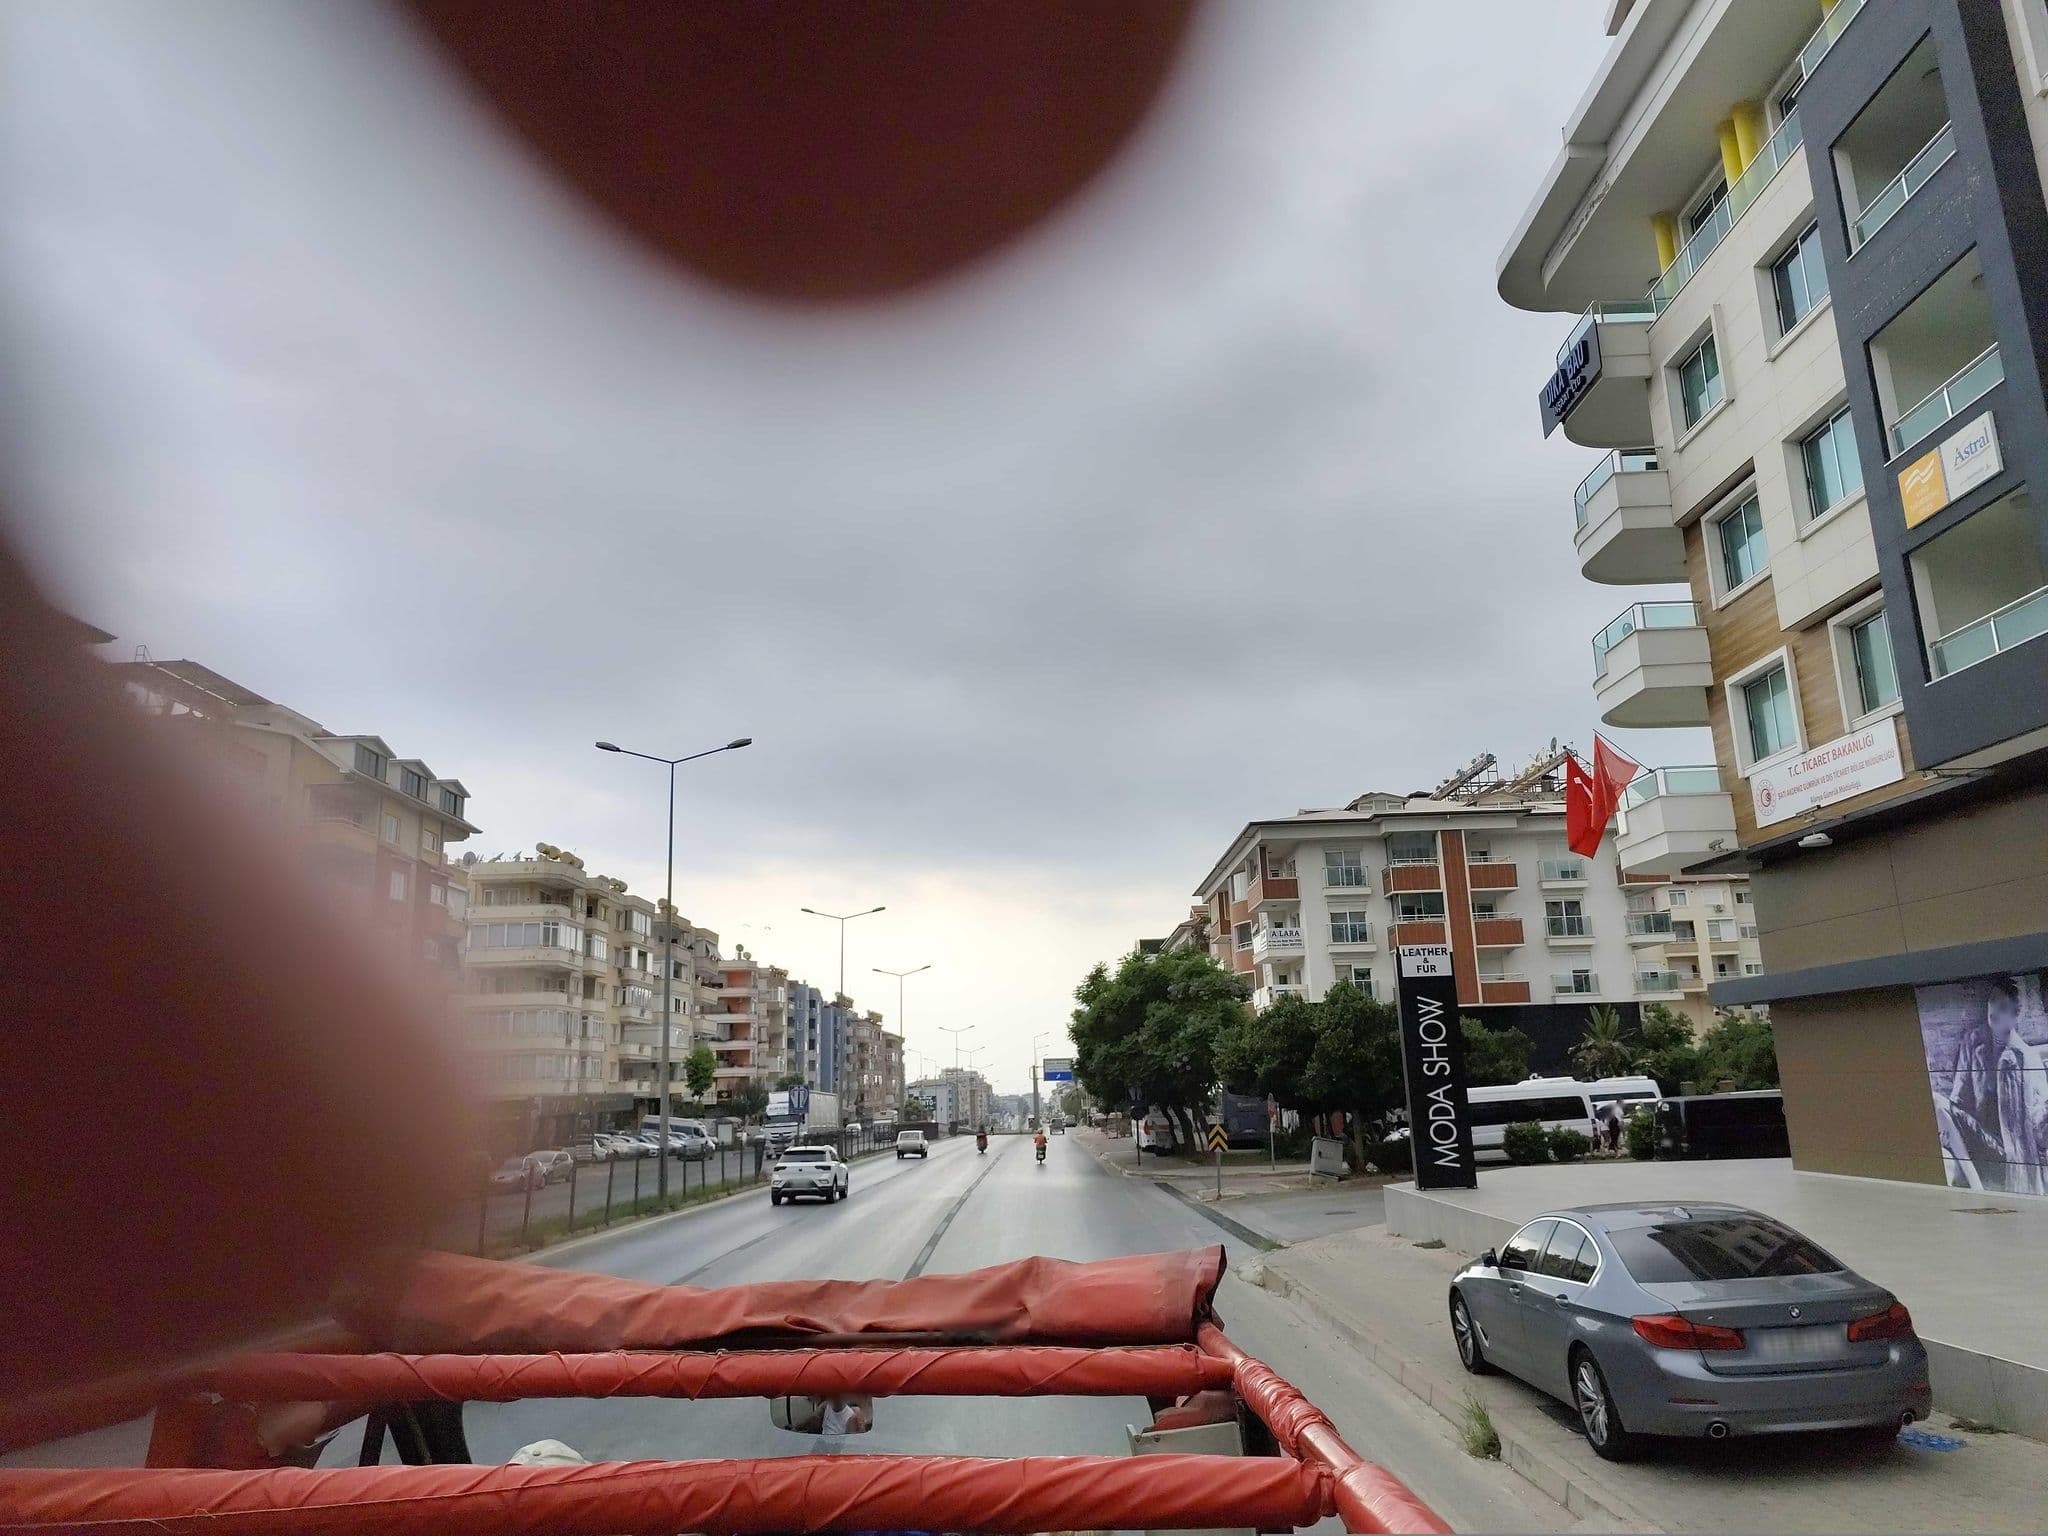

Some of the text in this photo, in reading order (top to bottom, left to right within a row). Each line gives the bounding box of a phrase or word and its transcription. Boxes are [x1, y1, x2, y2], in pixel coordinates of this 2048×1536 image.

[1954, 426, 1990, 466] Astral
[1788, 763, 1802, 777] T.C.
[1802, 752, 1831, 773] TİCARET
[1402, 947, 1448, 957] LEATHER
[1416, 964, 1437, 974] FUR
[1417, 996, 1461, 1167] MODA SHOW
